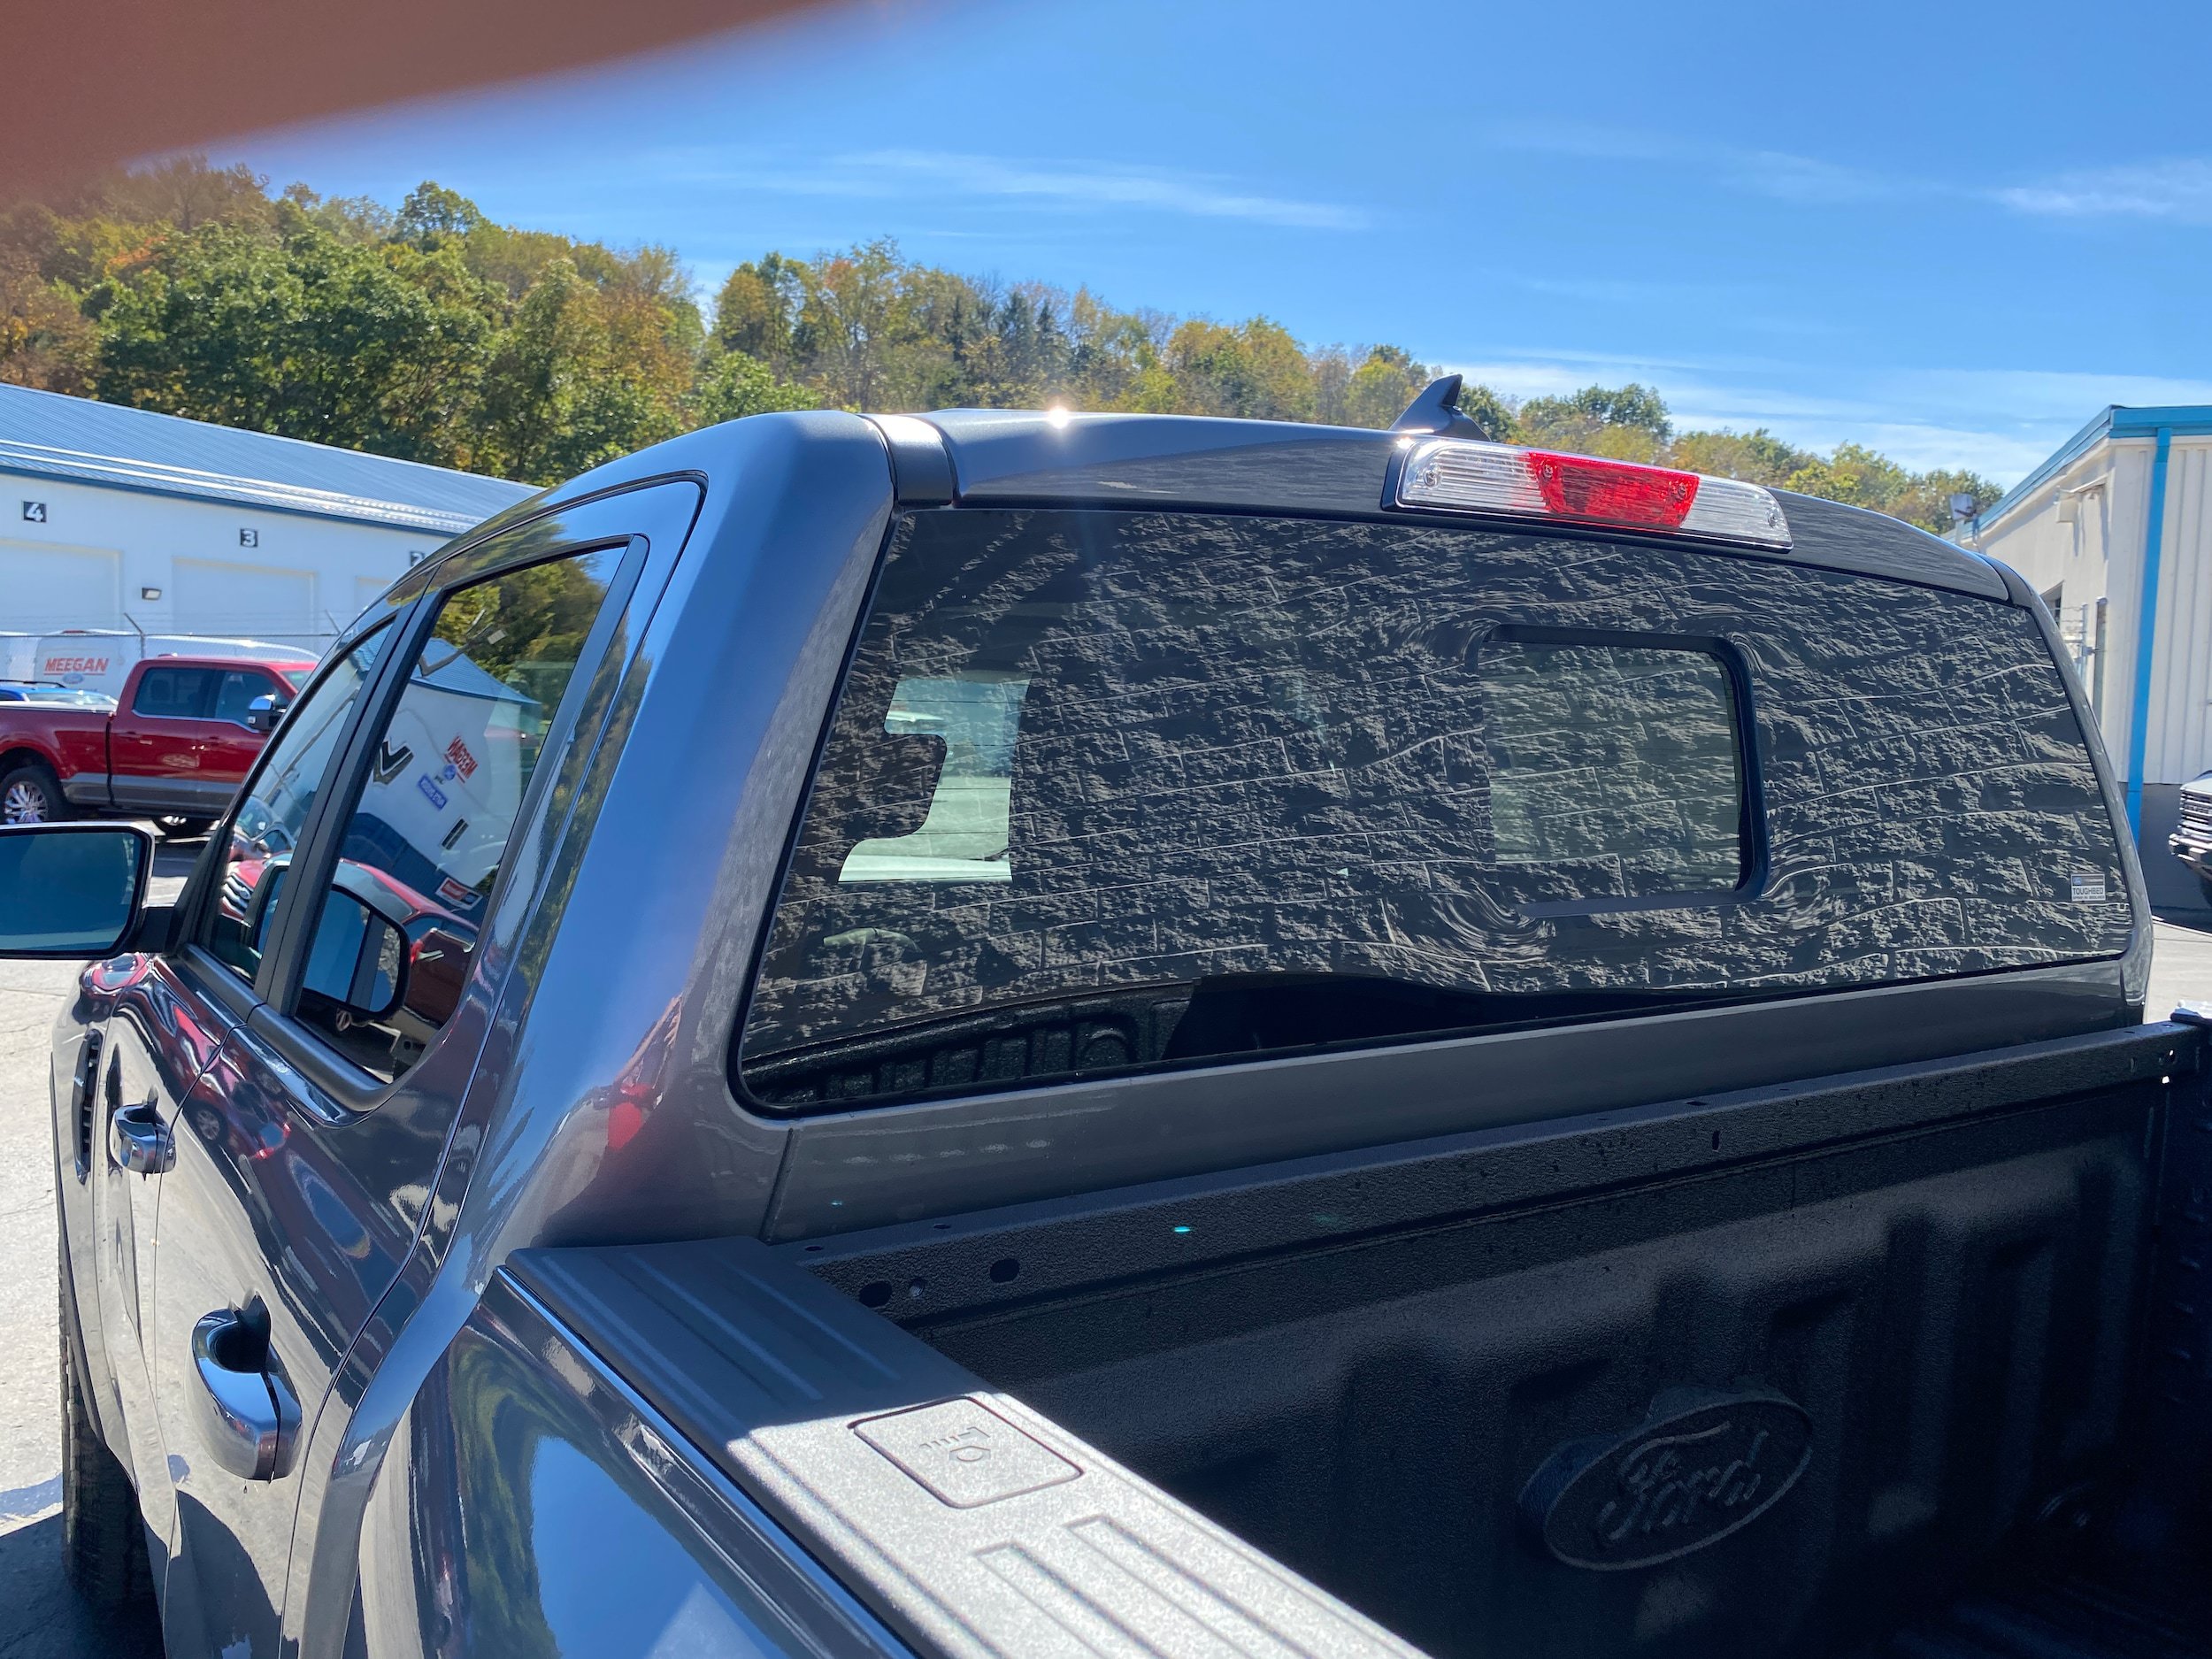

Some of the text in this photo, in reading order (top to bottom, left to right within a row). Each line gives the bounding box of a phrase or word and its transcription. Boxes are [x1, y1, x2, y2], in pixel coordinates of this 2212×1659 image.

[27, 503, 43, 522] 4
[242, 530, 256, 547] 3
[45, 657, 109, 672] MEEGAN
[1596, 1421, 1769, 1544] Ford
